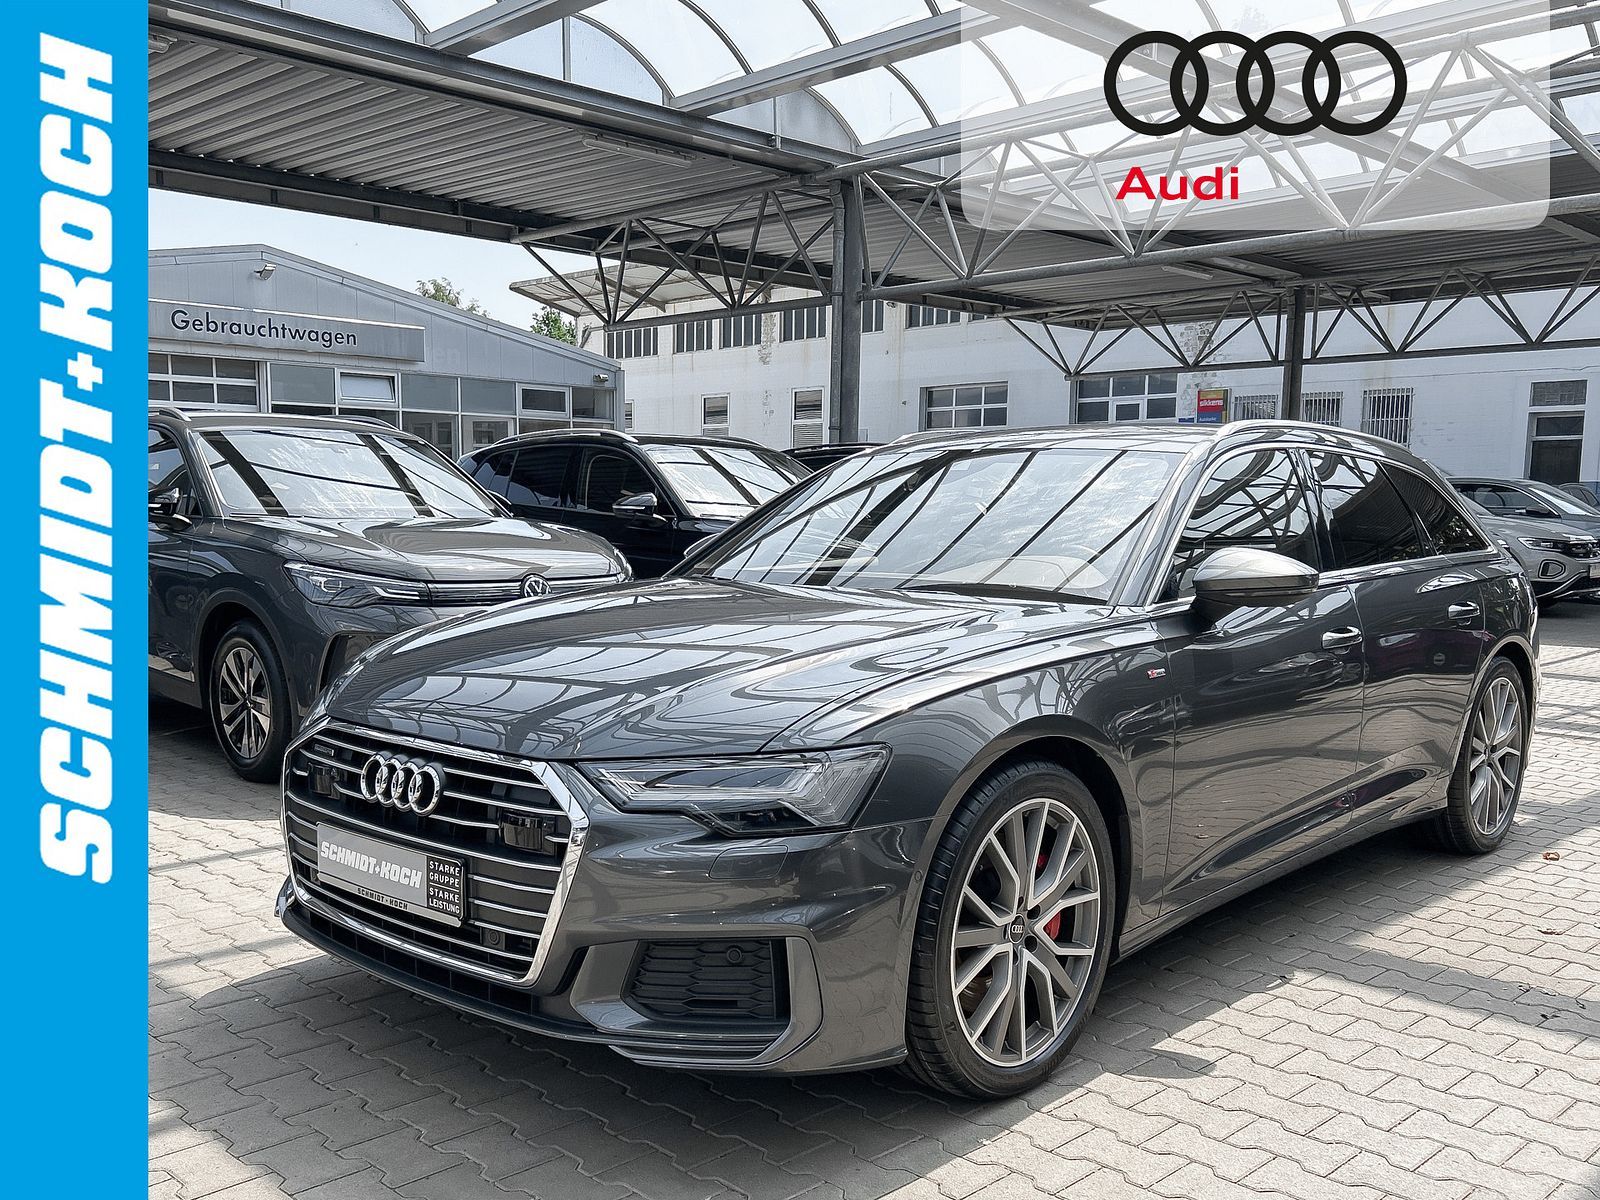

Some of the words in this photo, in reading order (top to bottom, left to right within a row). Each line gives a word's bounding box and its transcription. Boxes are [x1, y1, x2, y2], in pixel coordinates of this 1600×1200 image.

[171, 309, 357, 348] Gebrauchtwagen
[320, 841, 422, 888] SCHMIDT+KOCH
[429, 861, 460, 876] STARKE
[429, 872, 460, 888] GRUPPE
[429, 888, 460, 903] STARKE
[429, 898, 460, 914] LEISTUNG
